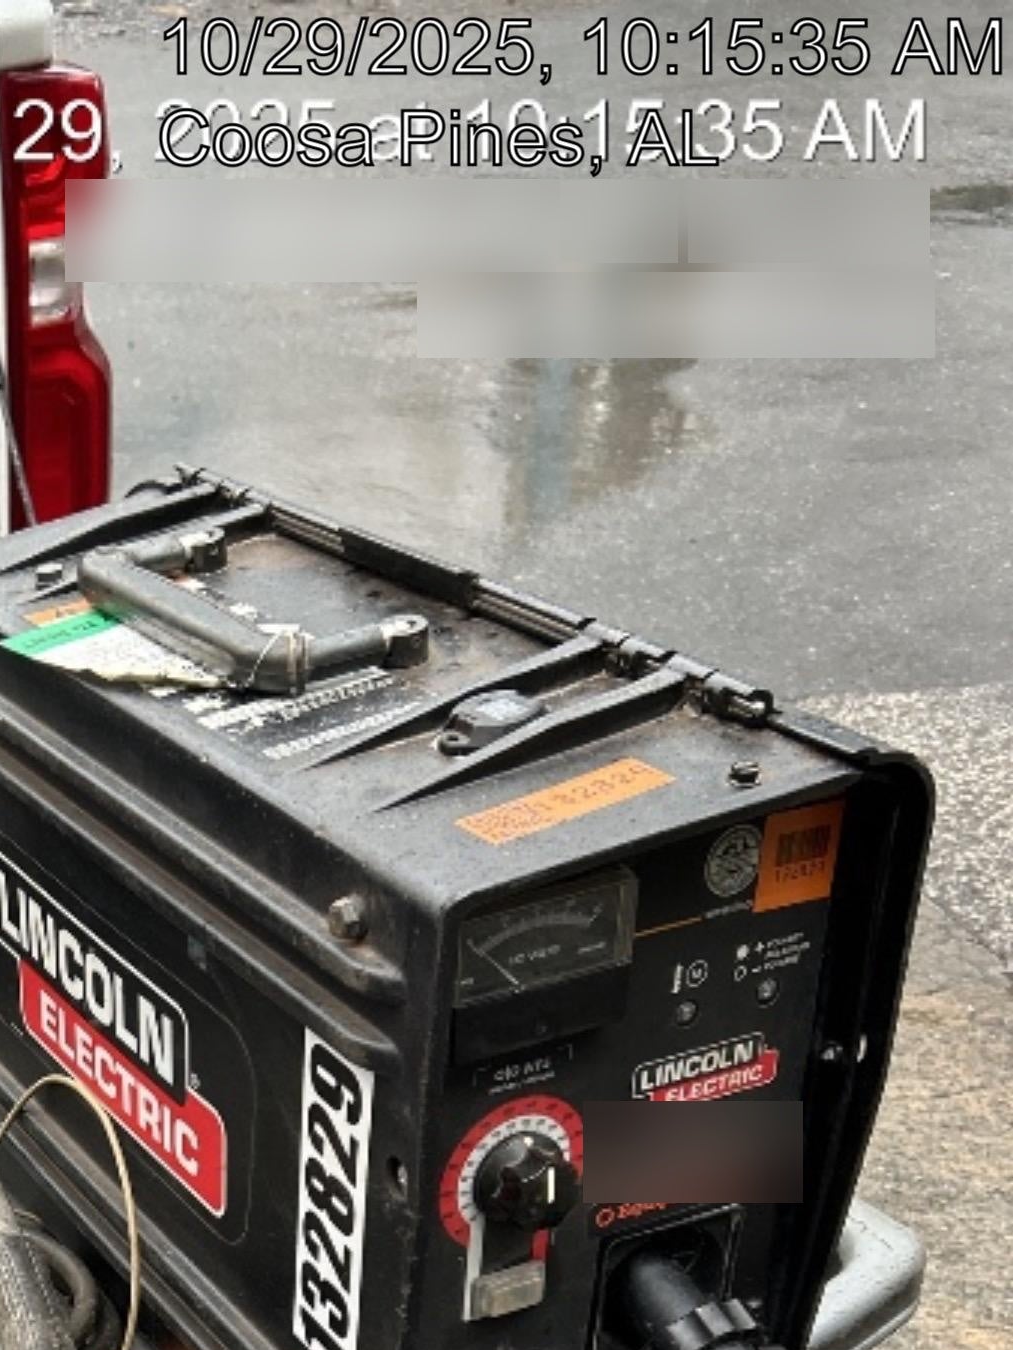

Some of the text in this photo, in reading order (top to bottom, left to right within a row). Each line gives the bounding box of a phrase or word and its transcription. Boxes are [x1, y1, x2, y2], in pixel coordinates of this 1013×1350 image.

[38, 989, 200, 1178] ELECTRIC
[639, 1038, 755, 1091] LINCOLN
[664, 1063, 763, 1101] ELECTRIC
